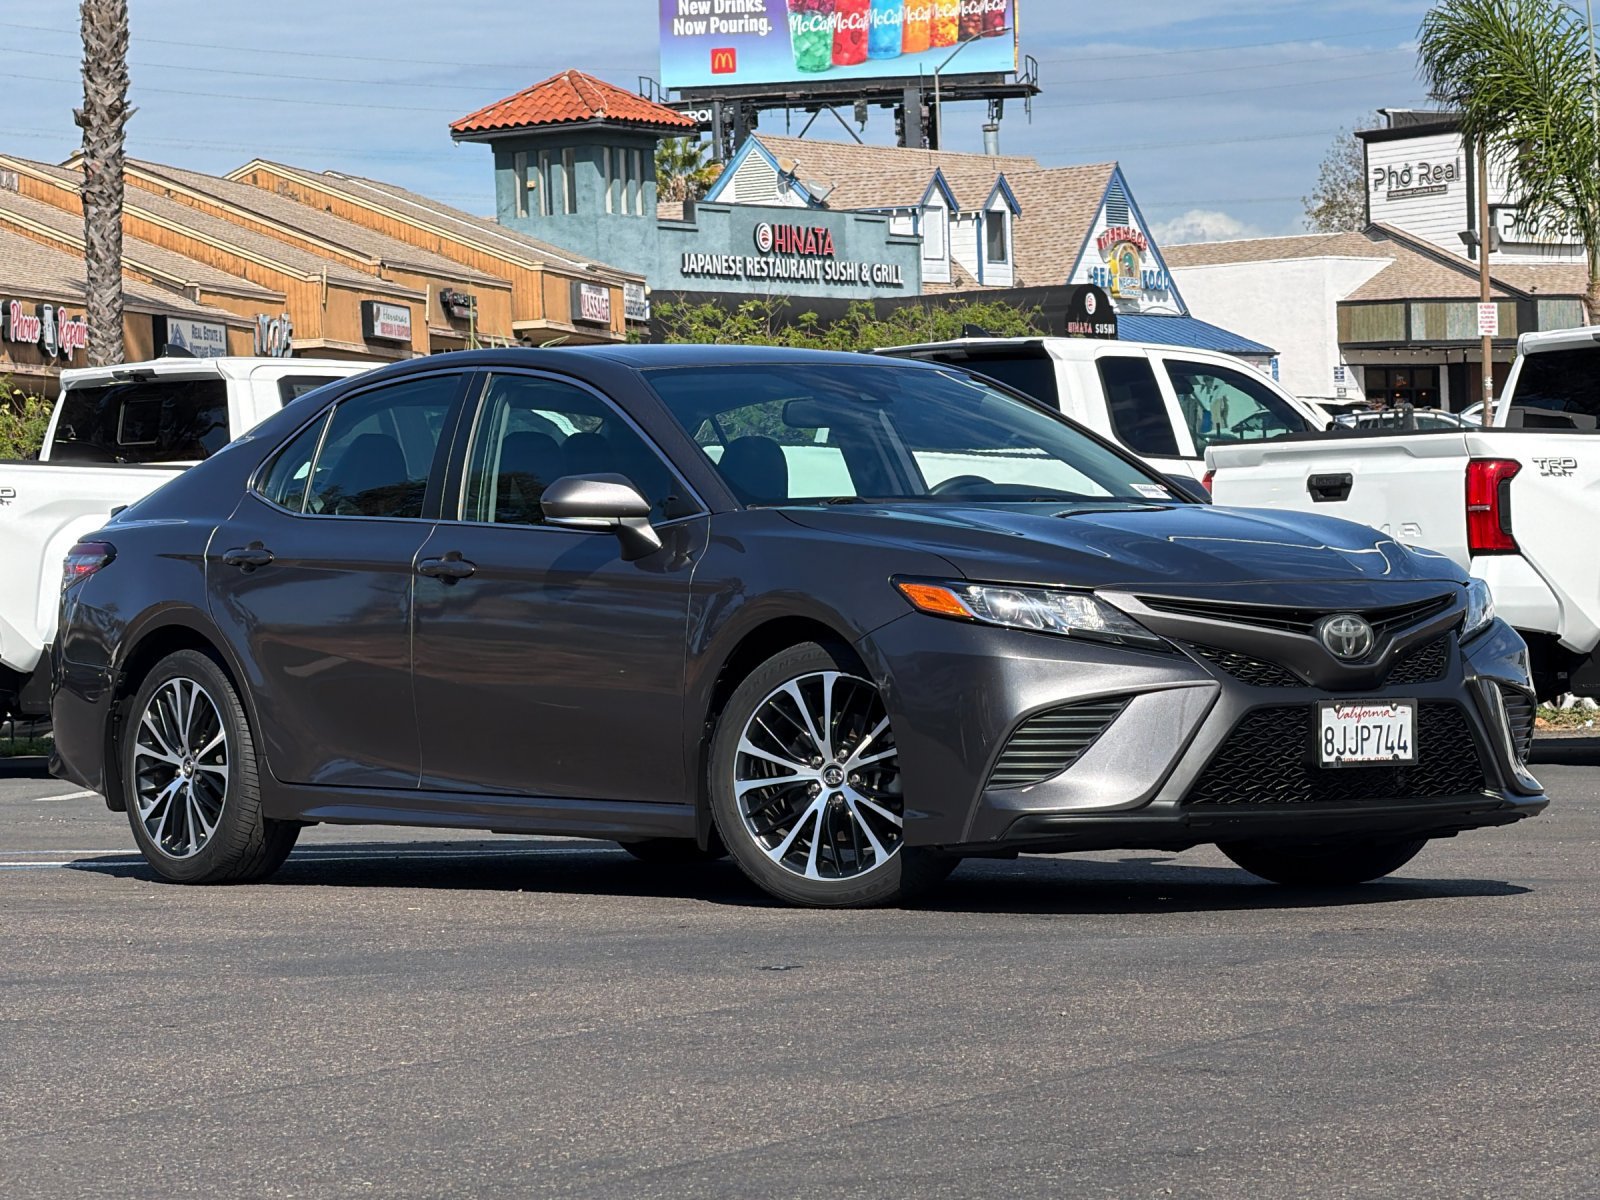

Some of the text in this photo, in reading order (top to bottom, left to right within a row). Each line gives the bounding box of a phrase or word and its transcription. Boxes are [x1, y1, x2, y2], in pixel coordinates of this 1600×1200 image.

[679, 0, 766, 15] New Drinks.
[673, 14, 772, 36] Now Pouring.
[1418, 157, 1461, 186] Real
[774, 223, 835, 256] HINATA
[1096, 226, 1148, 251] MARISCOS
[683, 253, 904, 284] JAPANESE RESTAURANT SUSHI & GRILL
[1093, 266, 1170, 291] SEA FOOD
[582, 293, 609, 321] MASSAGE
[10, 300, 41, 343] Phone
[58, 306, 88, 361] Repair
[1068, 321, 1115, 334] HINATA SUSHI
[1532, 457, 1577, 471] TRD
[1336, 706, 1396, 723] California
[1324, 725, 1408, 756] 8JJP744
